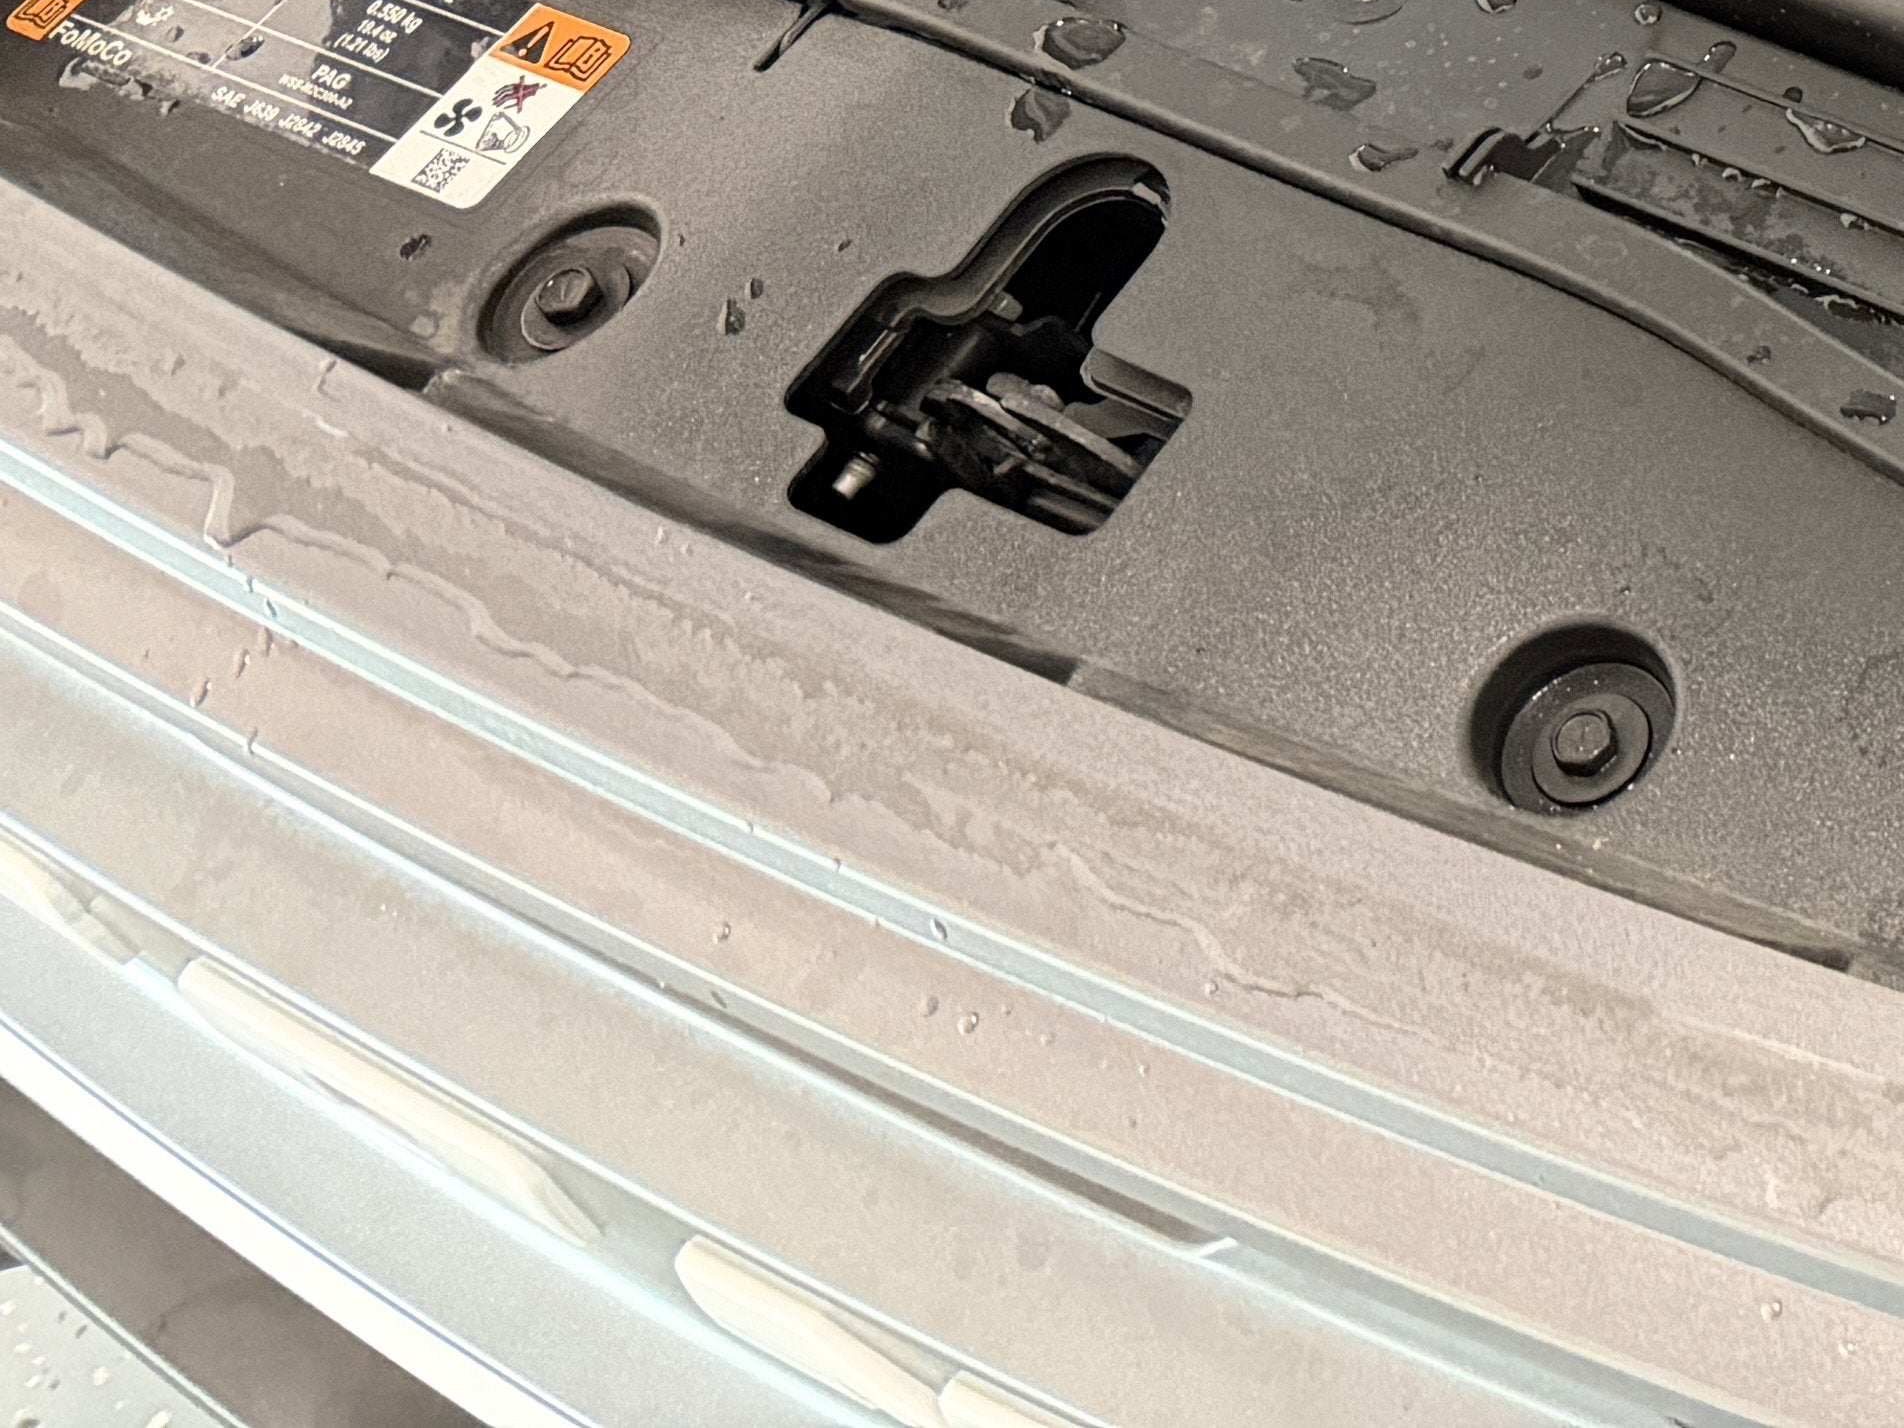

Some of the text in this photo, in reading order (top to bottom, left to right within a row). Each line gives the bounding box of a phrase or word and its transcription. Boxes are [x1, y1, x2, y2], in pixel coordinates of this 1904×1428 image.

[395, 12, 425, 32] kg
[49, 22, 135, 66] FoMoCo
[310, 66, 353, 90] PAG
[210, 86, 246, 107] SAE
